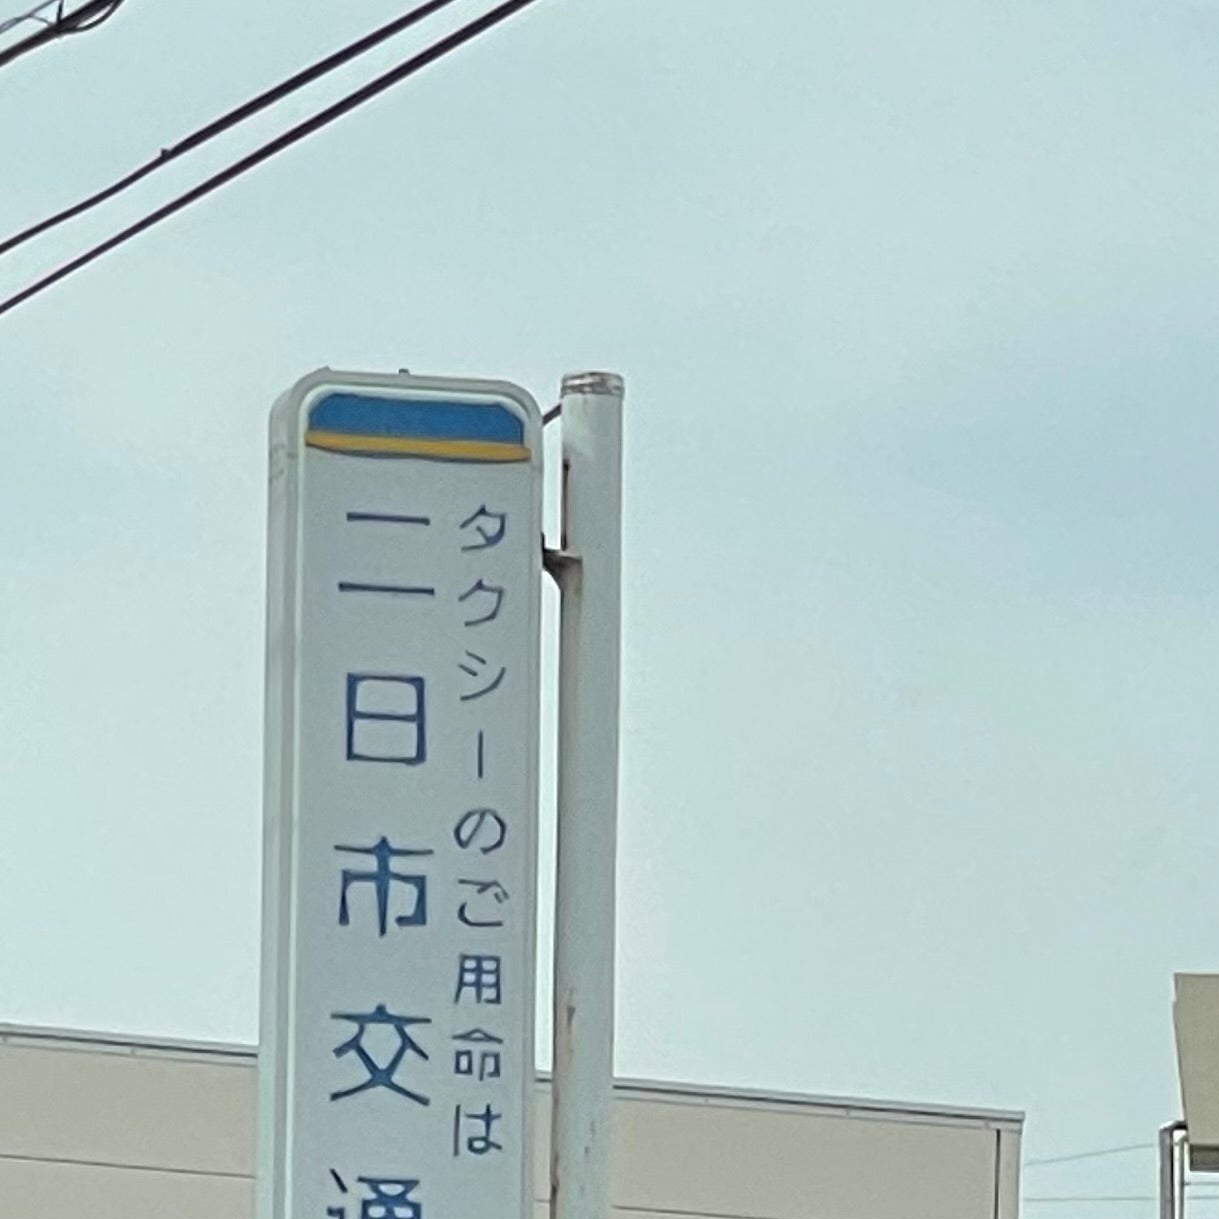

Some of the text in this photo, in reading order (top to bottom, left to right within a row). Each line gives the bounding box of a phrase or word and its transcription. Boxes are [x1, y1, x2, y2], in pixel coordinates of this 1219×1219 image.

[452, 503, 511, 1158] タクシーのご用命は
